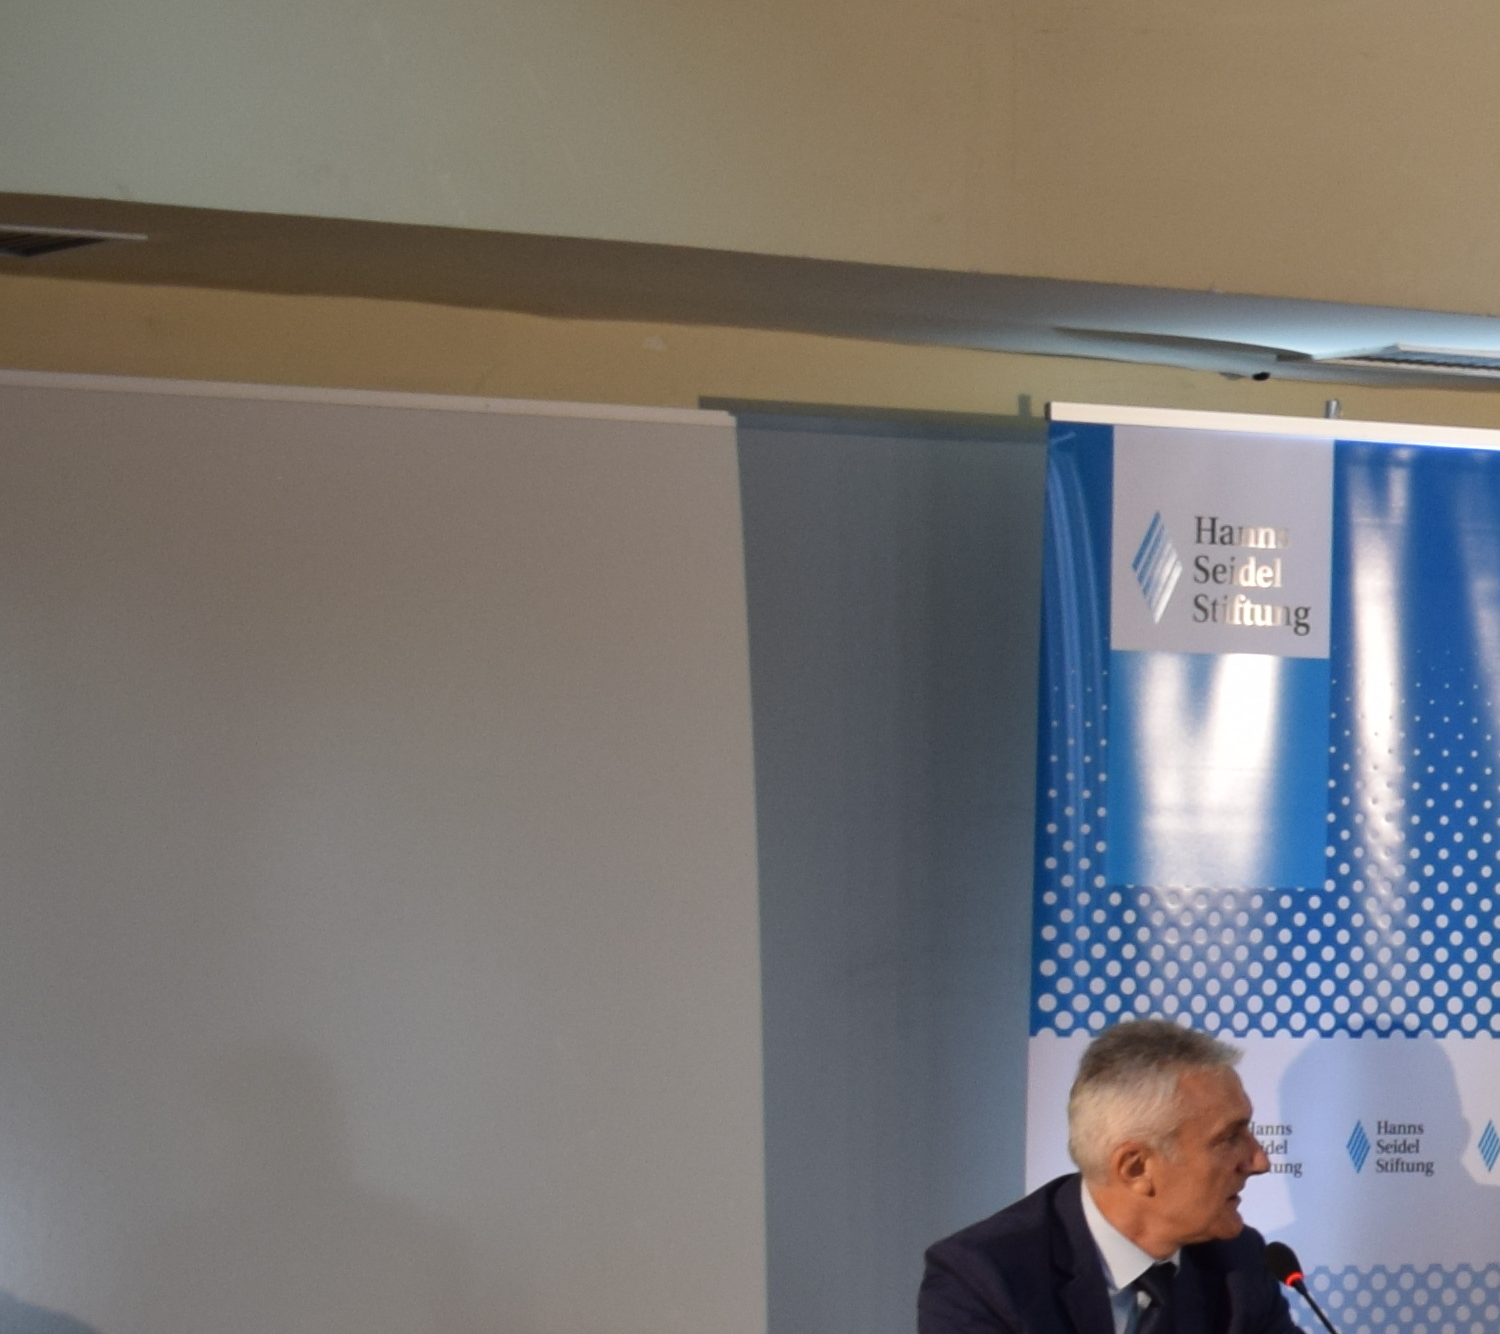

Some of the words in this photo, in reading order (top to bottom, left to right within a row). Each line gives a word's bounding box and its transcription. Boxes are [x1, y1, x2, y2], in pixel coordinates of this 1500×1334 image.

[1193, 515, 1291, 549] Hanns
[1193, 554, 1282, 588] Seidel
[1192, 593, 1312, 637] Stiftung
[1375, 1120, 1425, 1136] Hanns
[1375, 1139, 1420, 1154] Seidel
[1375, 1157, 1435, 1176] Stiftung
